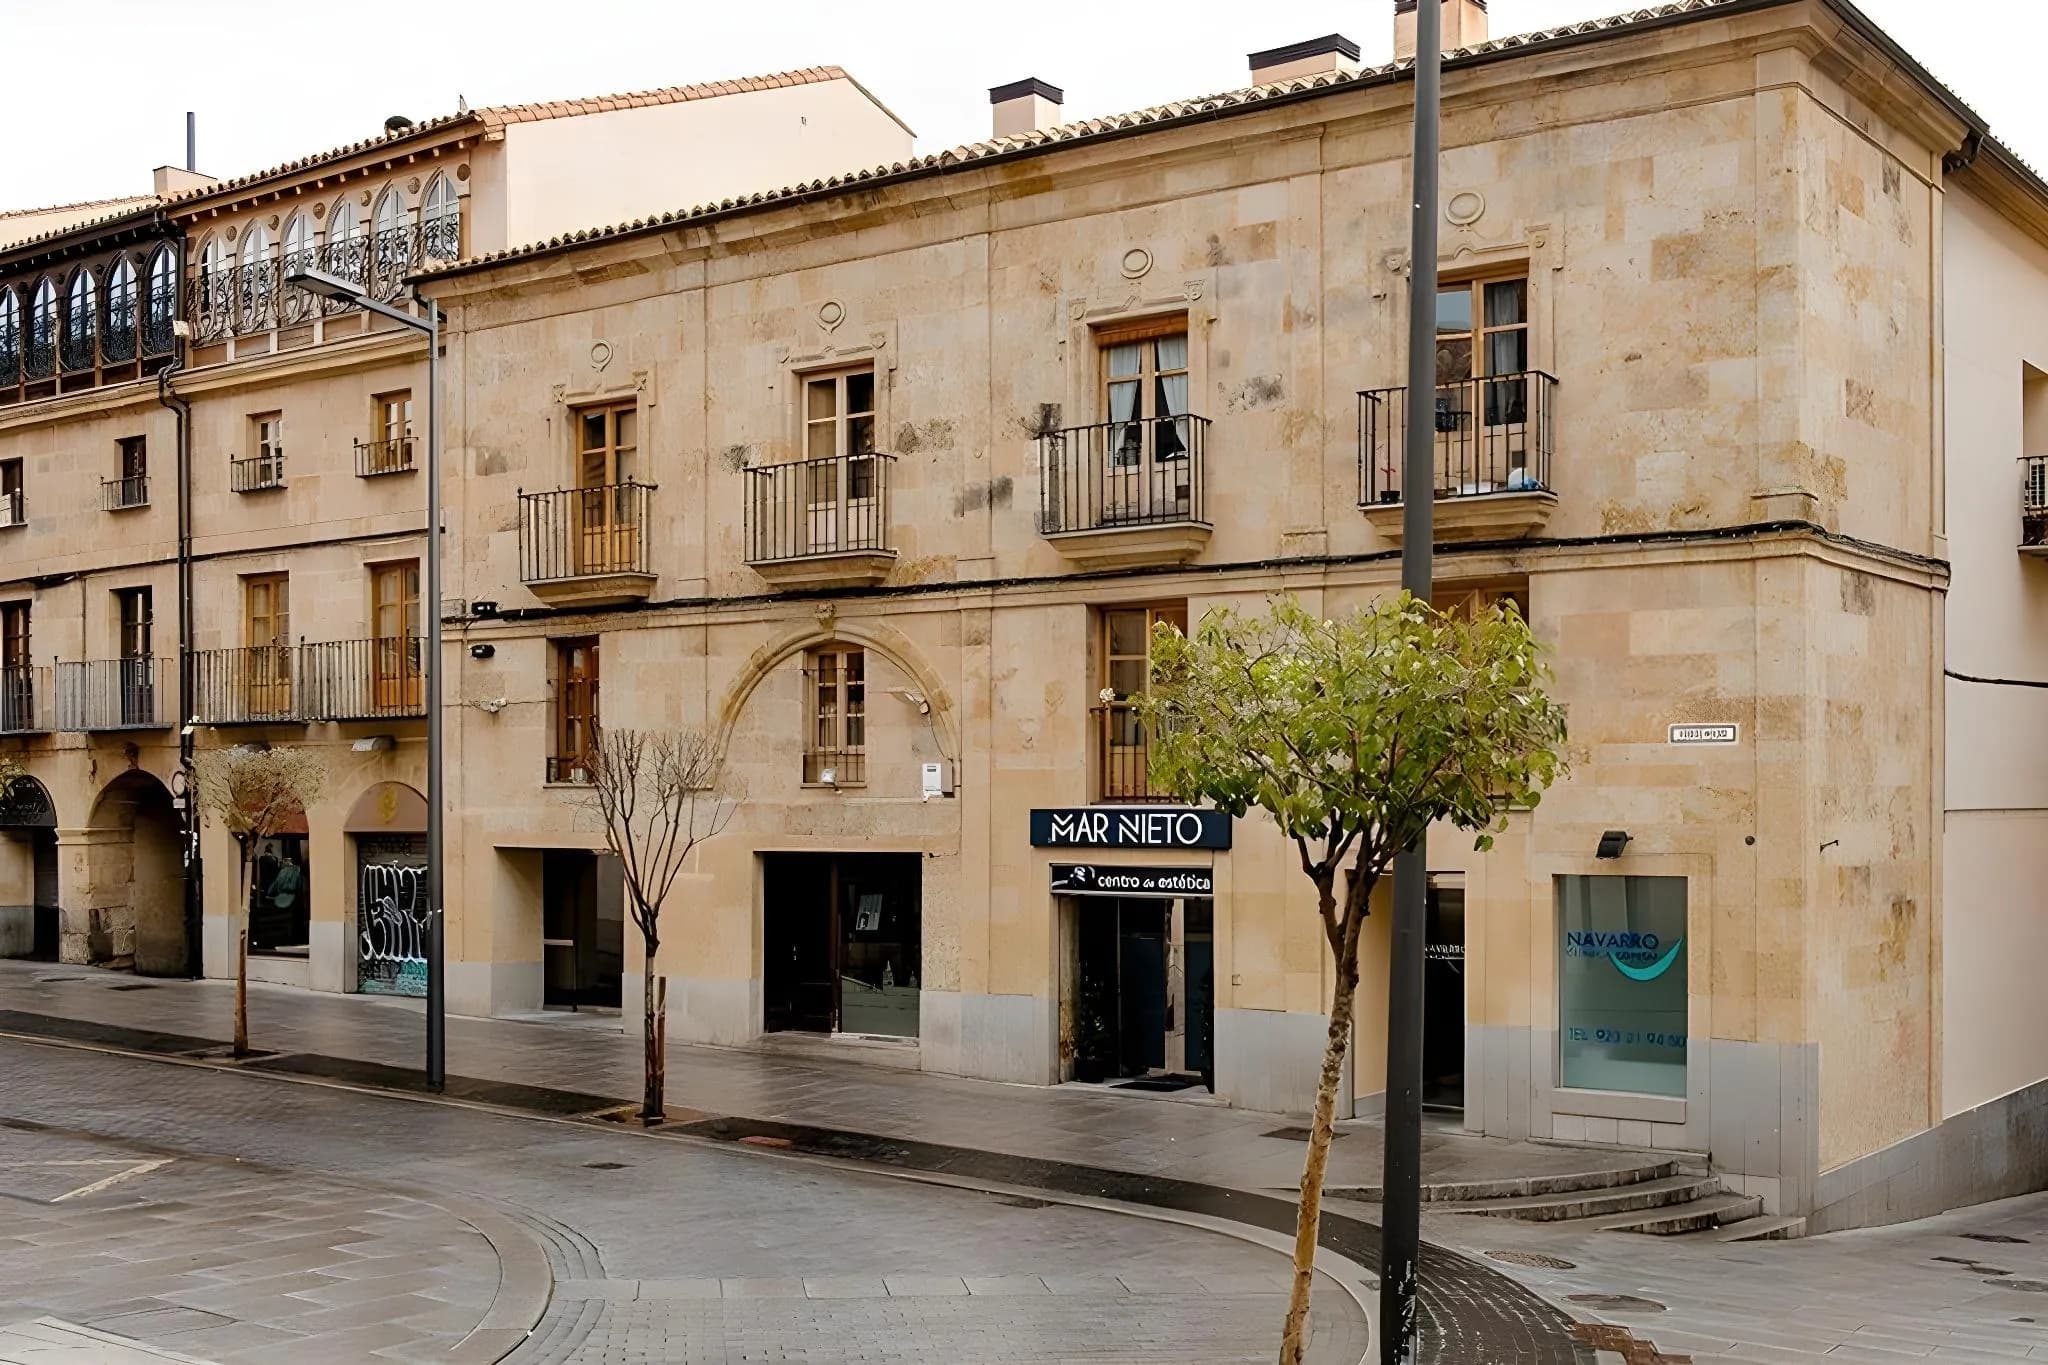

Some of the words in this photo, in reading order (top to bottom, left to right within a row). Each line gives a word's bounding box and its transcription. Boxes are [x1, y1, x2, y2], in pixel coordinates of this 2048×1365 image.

[1051, 812, 1109, 843] MAR
[1118, 812, 1203, 845] NIETO
[1097, 875, 1140, 888] centro
[1567, 932, 1659, 949] NAVARRO
